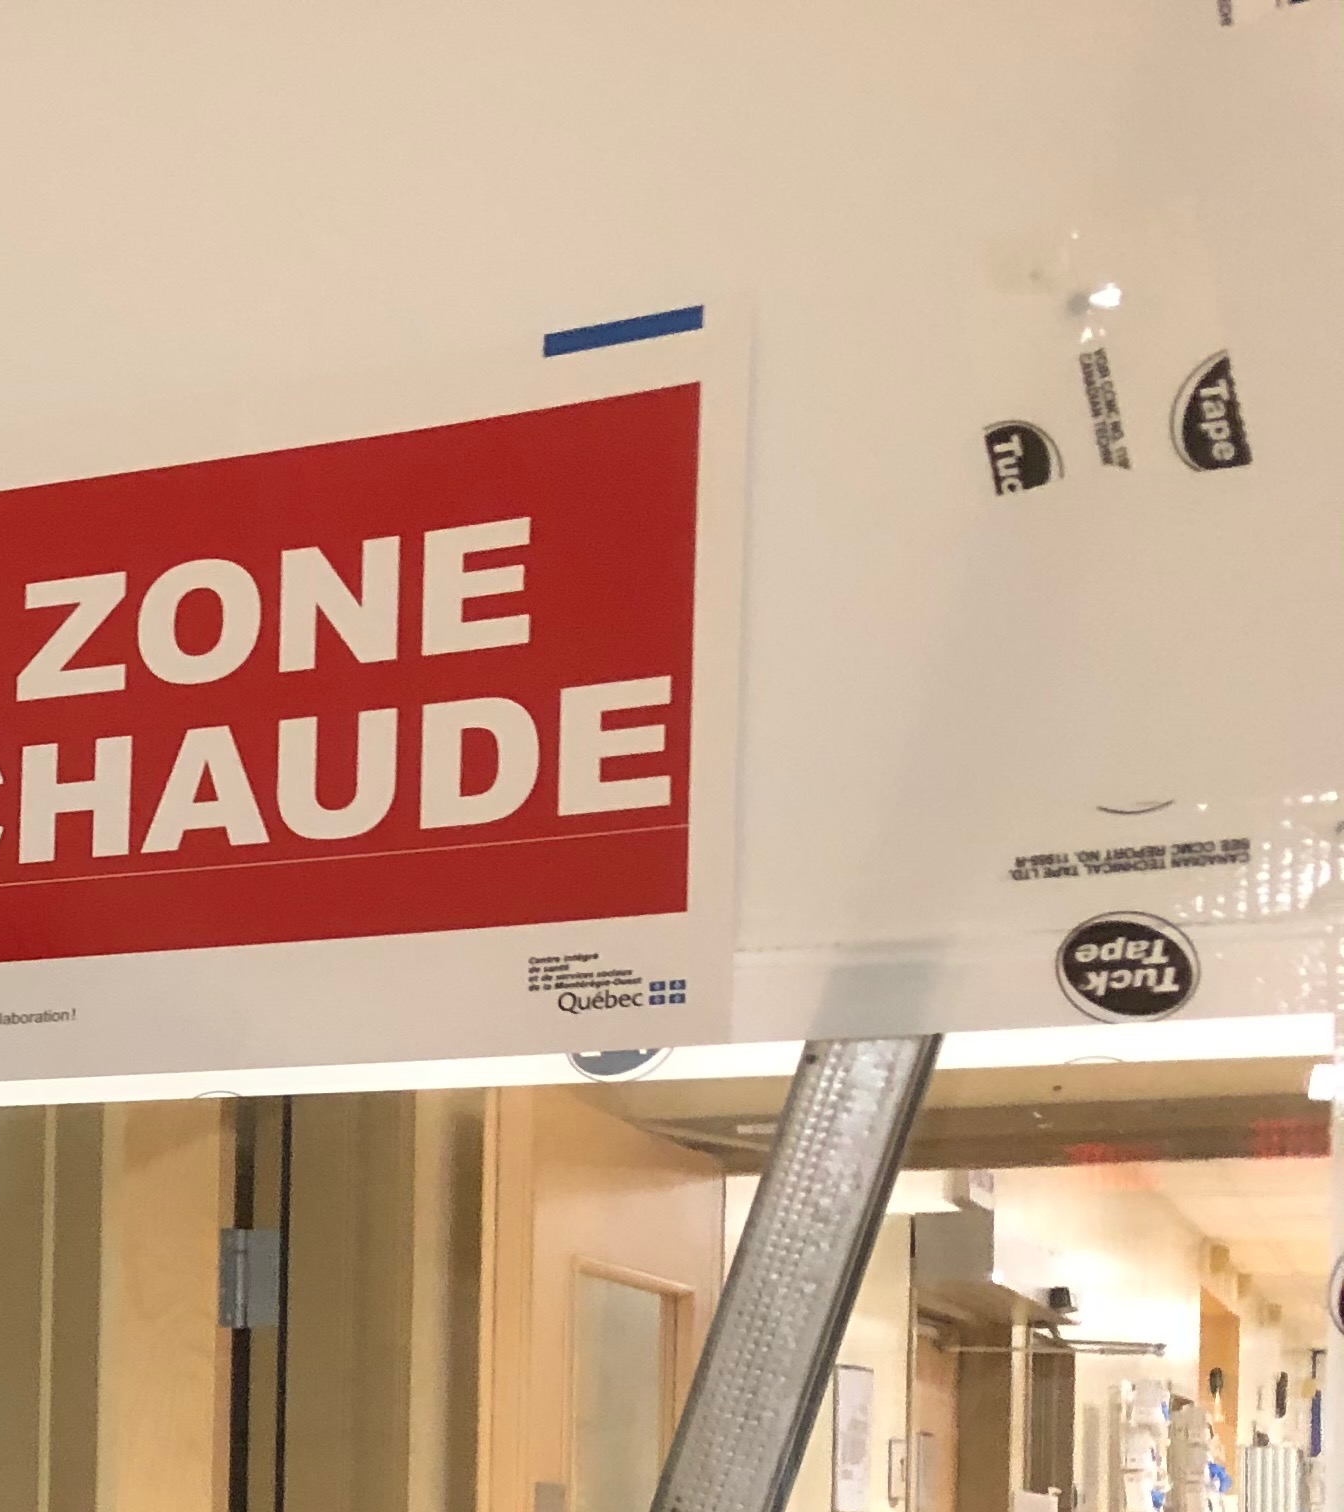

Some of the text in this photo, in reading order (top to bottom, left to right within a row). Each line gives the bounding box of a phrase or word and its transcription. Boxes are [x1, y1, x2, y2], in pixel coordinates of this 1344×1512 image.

[1199, 378, 1235, 462] Tape
[15, 516, 532, 703] ZONE
[528, 955, 561, 966] Centre
[1074, 936, 1171, 965] Tape
[528, 965, 541, 974] de
[528, 974, 538, 983] et
[541, 973, 553, 982] de
[555, 971, 594, 981] services
[1079, 966, 1181, 996] Tuck
[528, 983, 540, 992] de
[557, 990, 644, 1014] Québec
